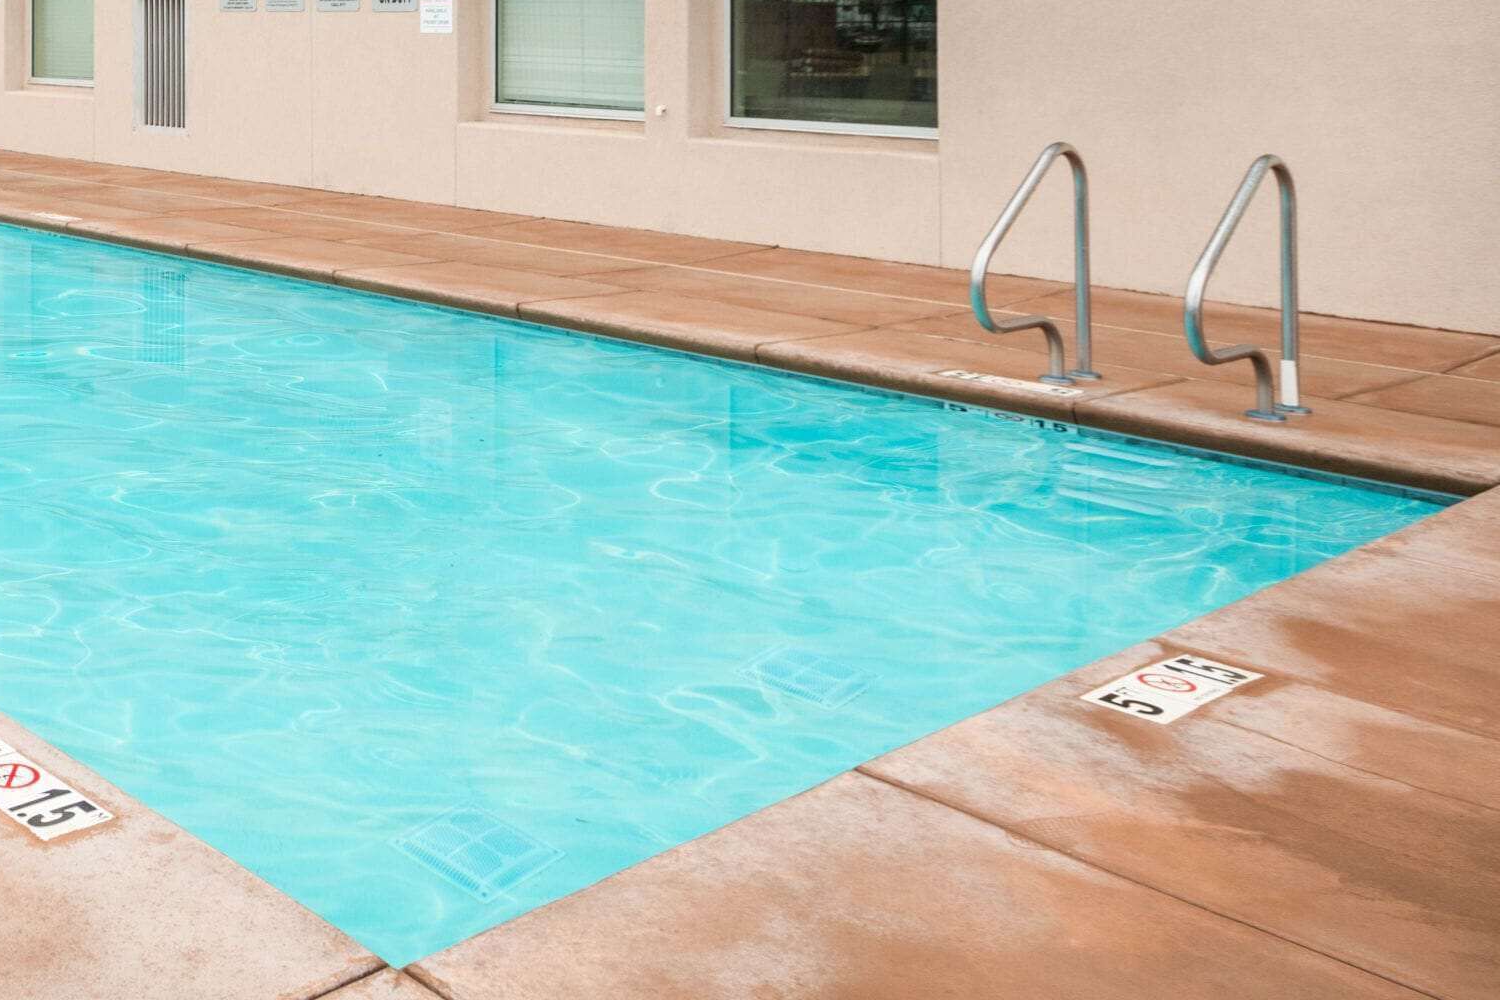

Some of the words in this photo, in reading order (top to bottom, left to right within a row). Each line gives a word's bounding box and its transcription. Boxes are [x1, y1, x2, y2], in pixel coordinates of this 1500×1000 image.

[1034, 420, 1068, 433] 1.5
[1098, 693, 1164, 715] 5
[8, 788, 98, 828] 1.5
